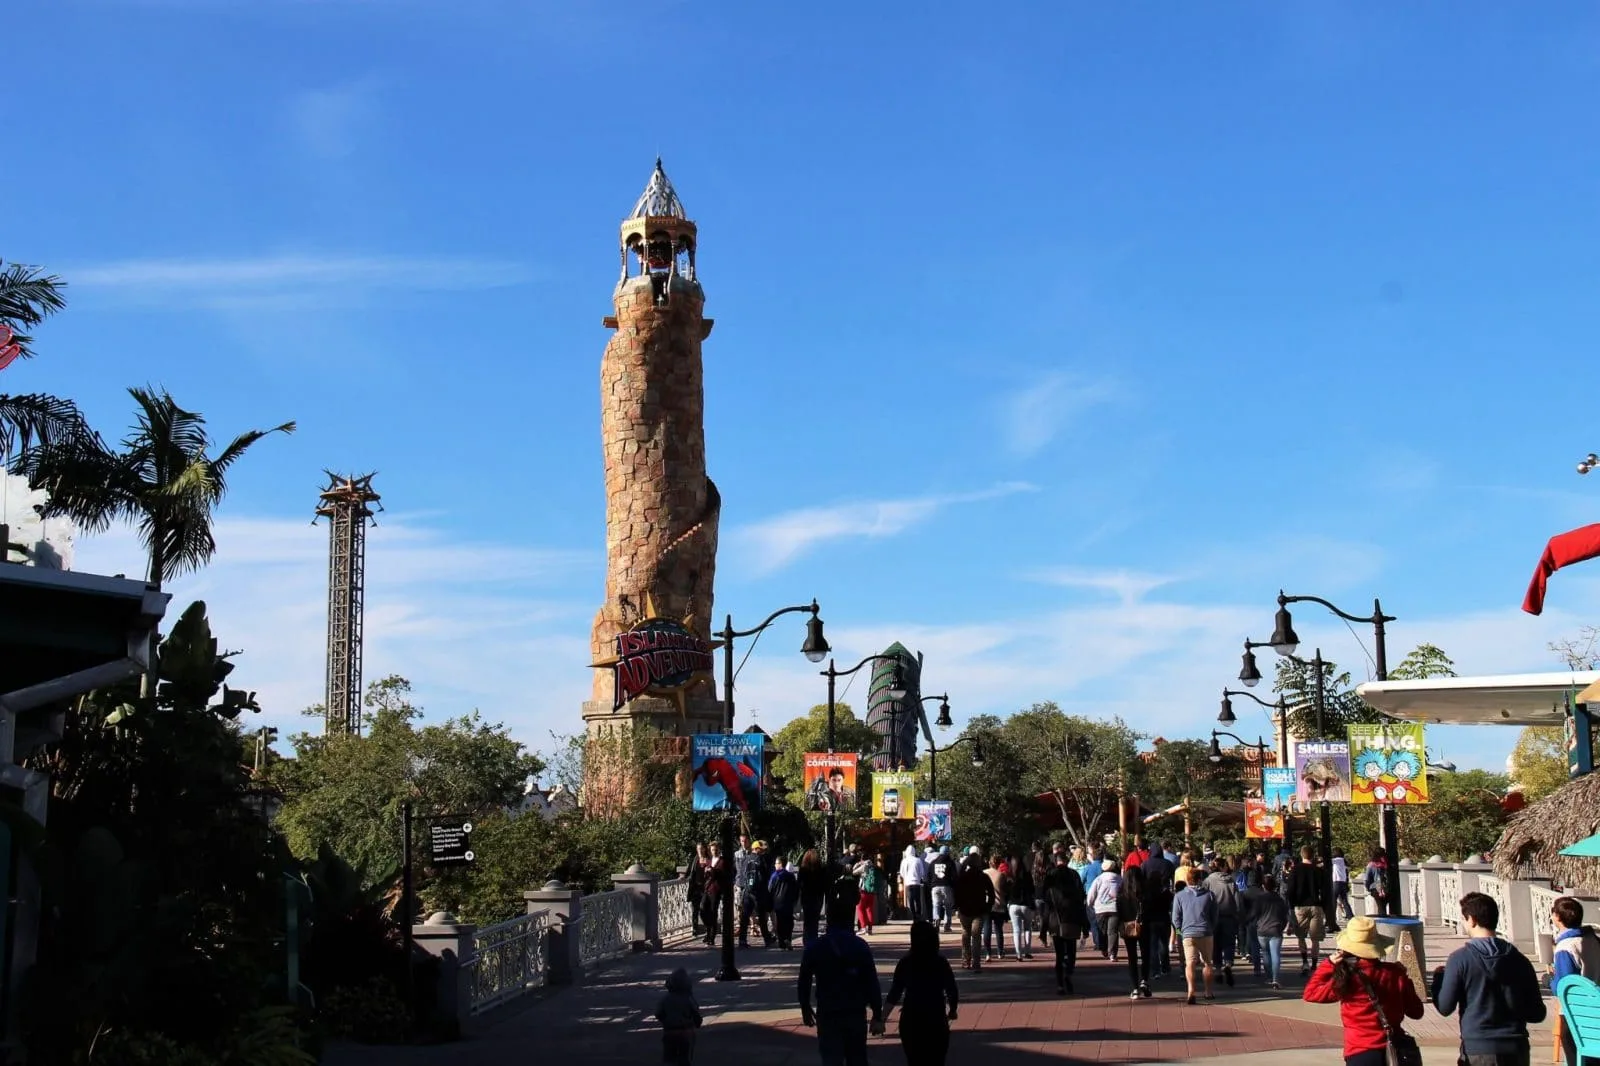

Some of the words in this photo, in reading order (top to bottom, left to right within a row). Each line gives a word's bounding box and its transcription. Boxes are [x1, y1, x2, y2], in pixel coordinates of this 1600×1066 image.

[615, 649, 712, 708] ADVEN
[1351, 726, 1371, 735] SEE
[696, 738, 720, 746] WALL
[696, 746, 725, 756] THIS
[728, 745, 758, 756] WAY.
[1298, 743, 1347, 754] SMILES
